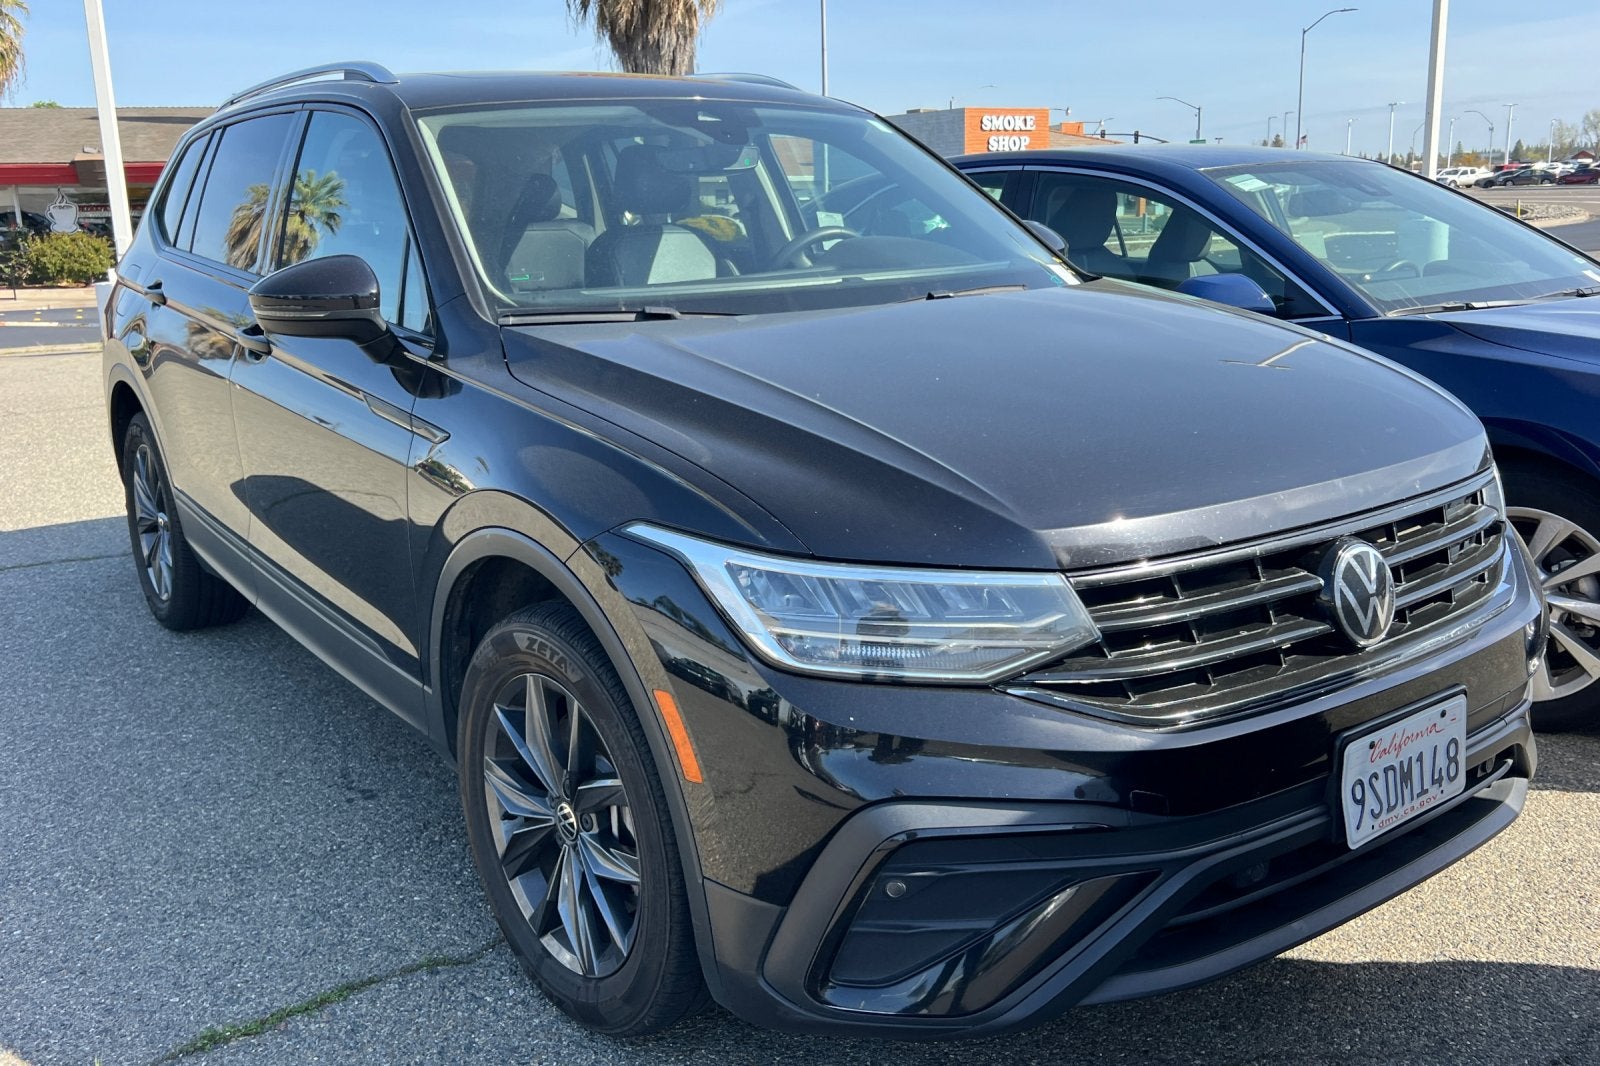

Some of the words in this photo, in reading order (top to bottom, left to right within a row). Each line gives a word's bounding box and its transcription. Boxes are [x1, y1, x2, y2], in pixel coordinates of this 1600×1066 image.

[982, 115, 1036, 131] SMOKE
[988, 135, 1030, 151] SHOP
[525, 637, 568, 674] ZETA
[1370, 722, 1445, 763] California
[1351, 737, 1459, 831] 9SDM148
[1378, 793, 1438, 829] dmv.ca.gov
